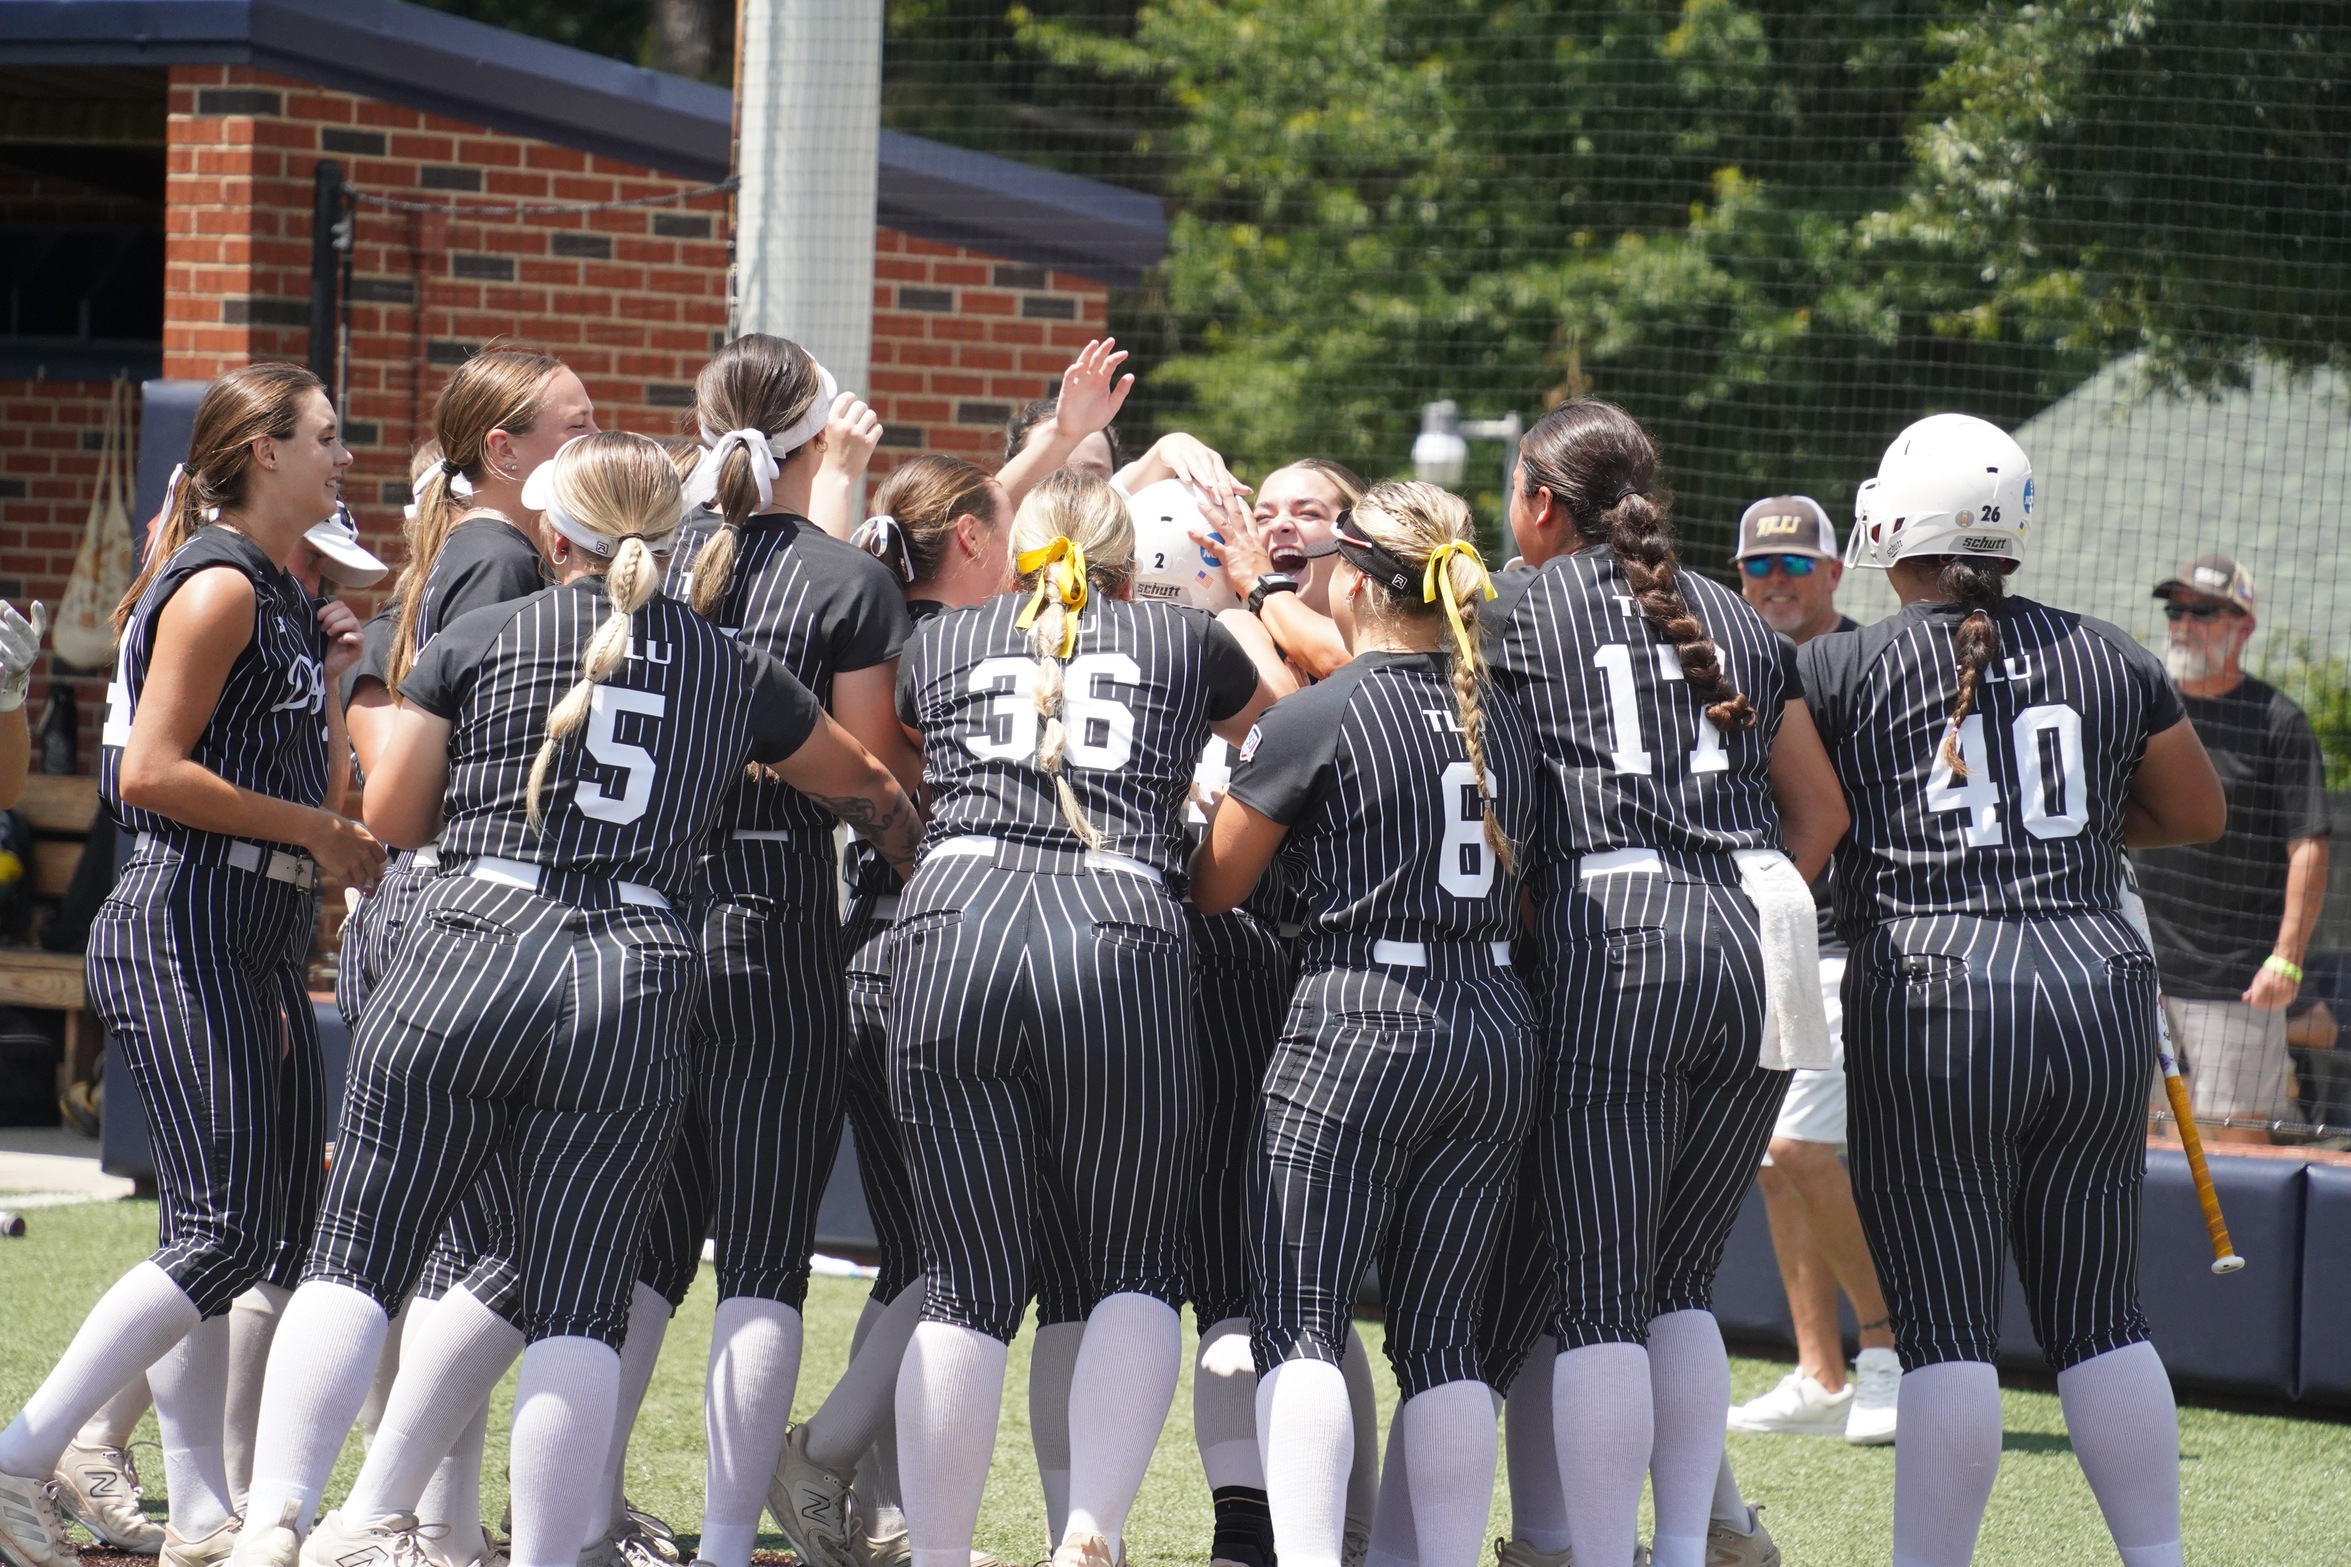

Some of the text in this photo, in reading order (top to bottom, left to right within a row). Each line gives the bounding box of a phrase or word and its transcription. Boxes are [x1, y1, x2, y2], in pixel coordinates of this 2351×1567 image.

[1981, 505, 2000, 522] 26
[1962, 536, 2007, 549] schutt
[1154, 552, 1165, 569] 2
[1137, 582, 1181, 597] schutt
[622, 636, 673, 664] LU
[1983, 654, 2032, 684] LU
[966, 653, 1141, 771] 36
[1423, 709, 1485, 732] TL
[573, 683, 666, 826] 5
[1925, 704, 2089, 848] 40
[1438, 762, 1497, 898] 6
